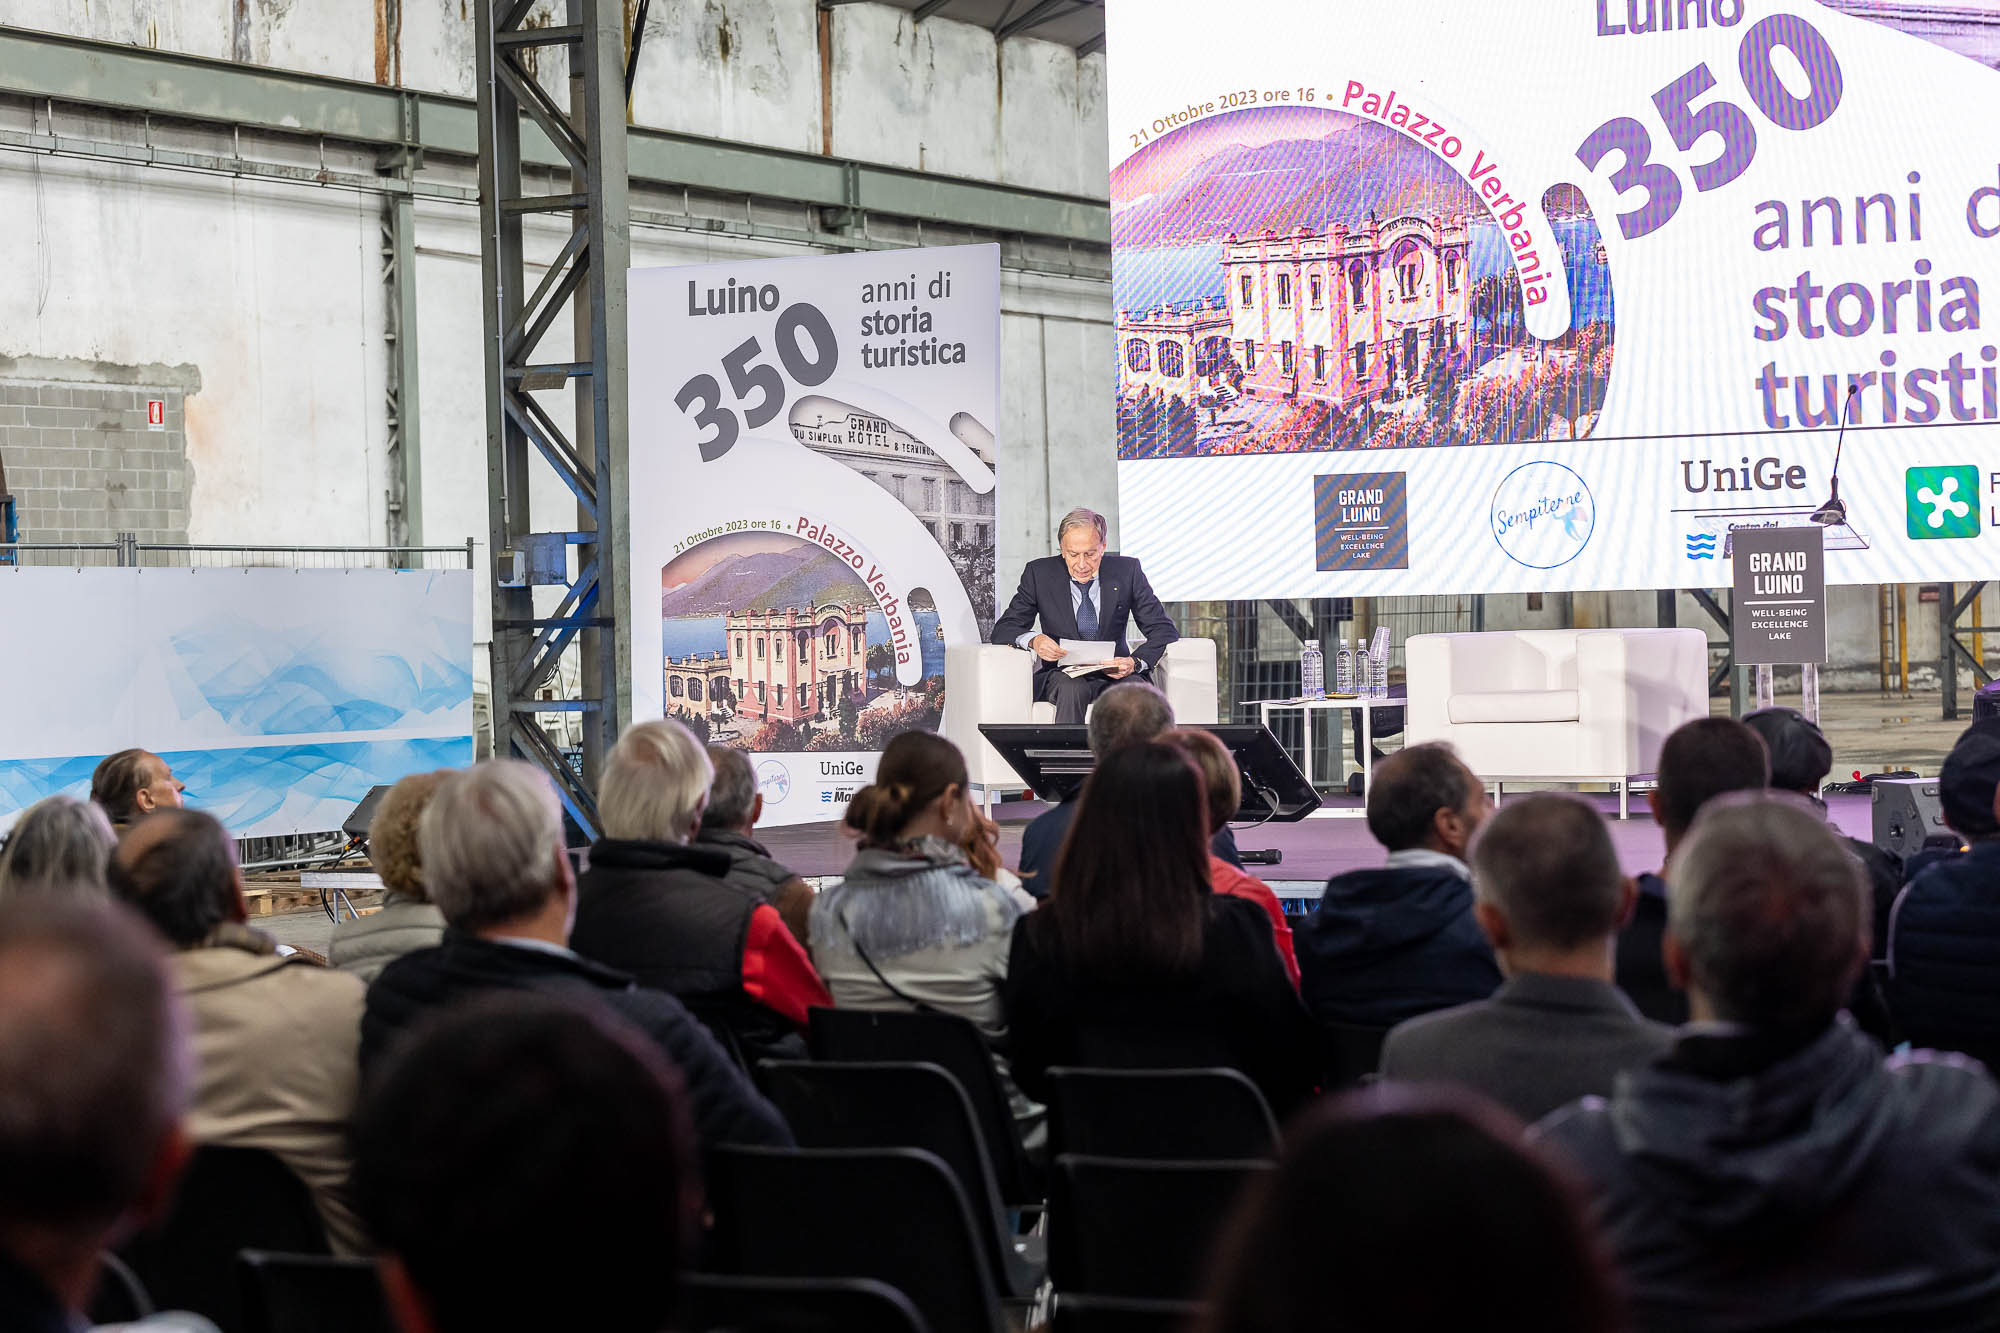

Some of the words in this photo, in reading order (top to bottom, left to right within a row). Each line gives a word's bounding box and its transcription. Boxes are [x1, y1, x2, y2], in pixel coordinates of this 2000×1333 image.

[1597, 0, 1744, 36] Luino
[1575, 13, 1843, 240] 350
[1129, 130, 1149, 148] 21
[1152, 101, 1214, 134] Ottobre
[1219, 89, 1258, 110] 2023
[1263, 88, 1290, 101] ore
[1296, 88, 1315, 102] 16
[1342, 79, 1462, 159] Palazzo
[1466, 151, 1553, 307] Verbania
[1753, 171, 1922, 252] anni
[688, 278, 780, 316] Luino
[861, 273, 916, 304] anni
[928, 271, 951, 298] di
[1752, 259, 1980, 342] storia
[861, 306, 933, 337] storia
[861, 337, 966, 369] turistica
[674, 303, 838, 462] 350
[1755, 345, 1998, 430] turisti
[795, 429, 805, 439] DU
[808, 432, 842, 444] SIMPLON
[850, 418, 888, 434] GRAND
[903, 443, 935, 455] TERMINUS
[1681, 457, 1807, 493] UniGe
[1338, 489, 1384, 506] GRAND
[1498, 489, 1583, 535] Sempiterne
[1342, 507, 1381, 523] LUINO
[1340, 532, 1384, 541] WELL-BEING
[1340, 541, 1385, 550] EXCELLENCE
[1749, 551, 1807, 573] GRAND
[673, 541, 686, 554] 21
[686, 524, 723, 547] Ottobre
[725, 519, 748, 532] 2023
[751, 520, 767, 529] ore
[770, 520, 781, 530] 16
[796, 516, 864, 570] Palazzo
[866, 565, 913, 665] Verbania
[1754, 574, 1804, 596] LUINO
[1751, 608, 1808, 618] WELL-BEING
[1751, 620, 1809, 630] EXCELLENCE
[1768, 632, 1792, 641] LAKE
[820, 761, 864, 776] UniGe
